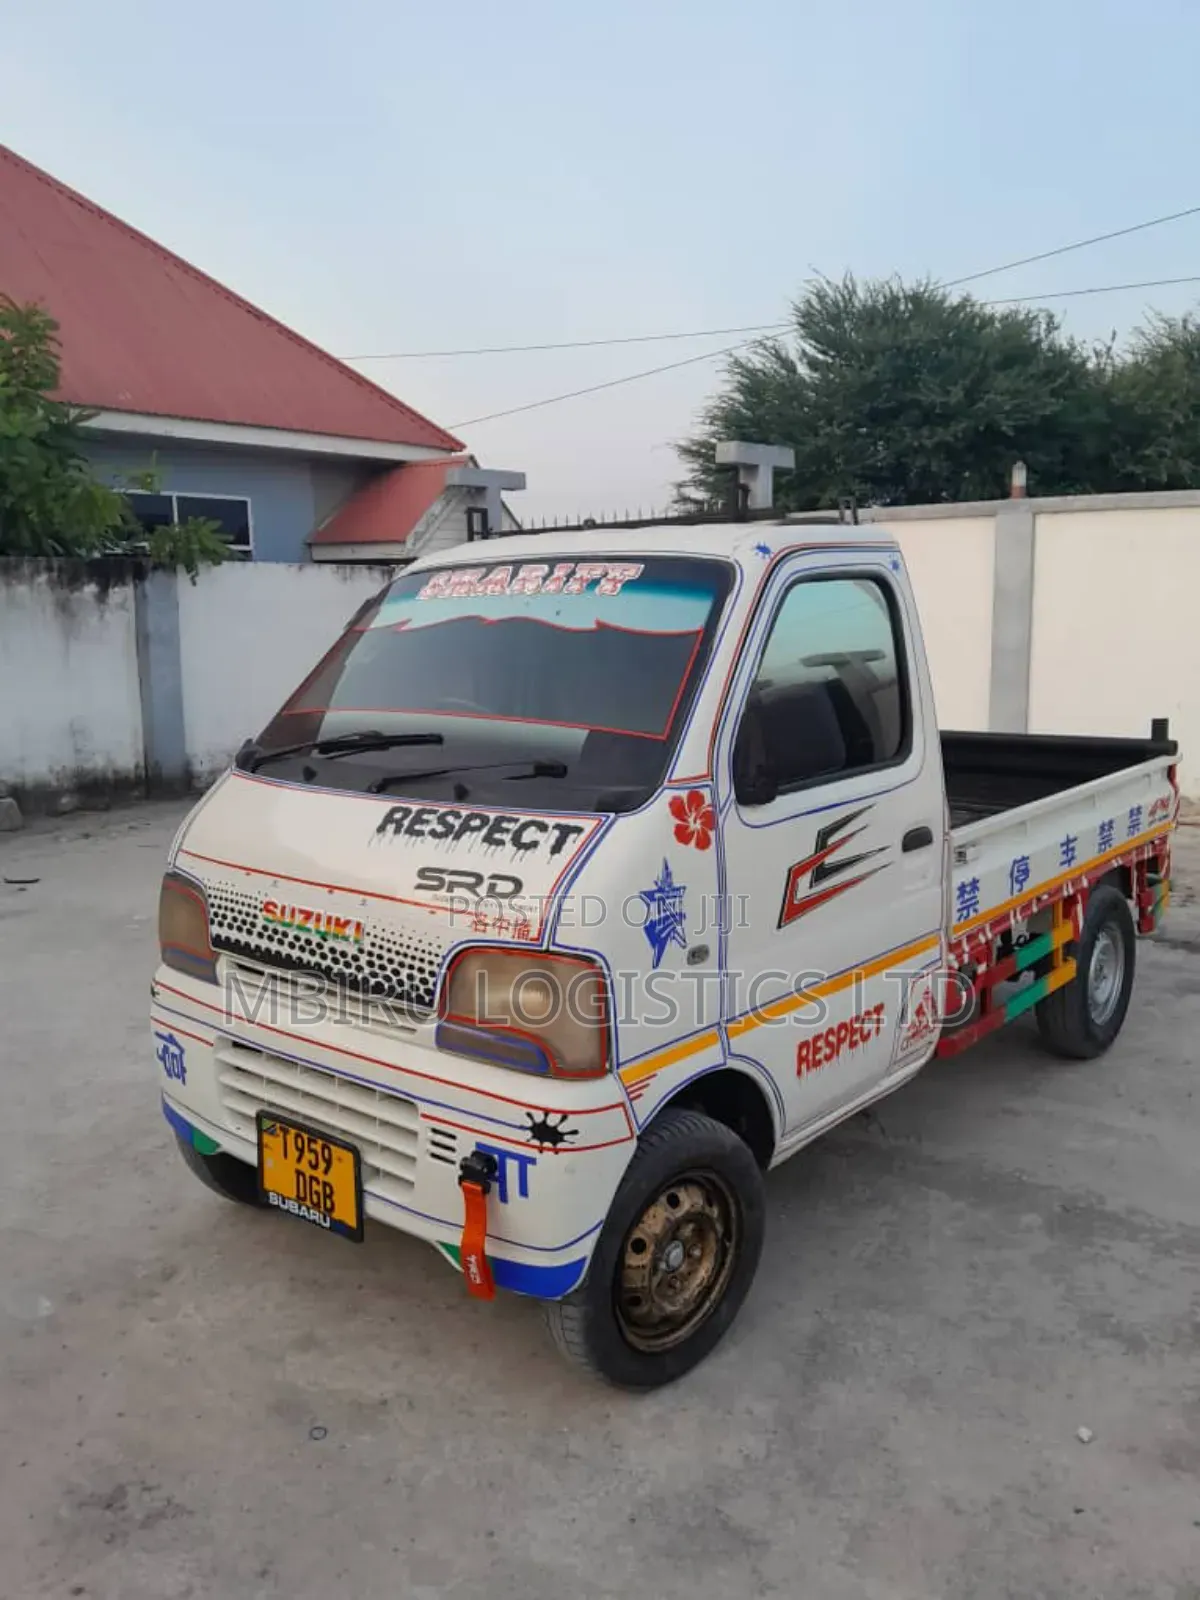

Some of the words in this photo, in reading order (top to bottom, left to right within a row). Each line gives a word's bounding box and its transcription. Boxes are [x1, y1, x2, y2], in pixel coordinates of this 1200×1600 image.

[374, 805, 585, 858] RESPECT
[414, 866, 524, 899] SRD
[262, 900, 364, 945] SUZUKI
[796, 1002, 885, 1080] RESPECT
[269, 1191, 331, 1228] SUBARU
[295, 1168, 335, 1215] DGB
